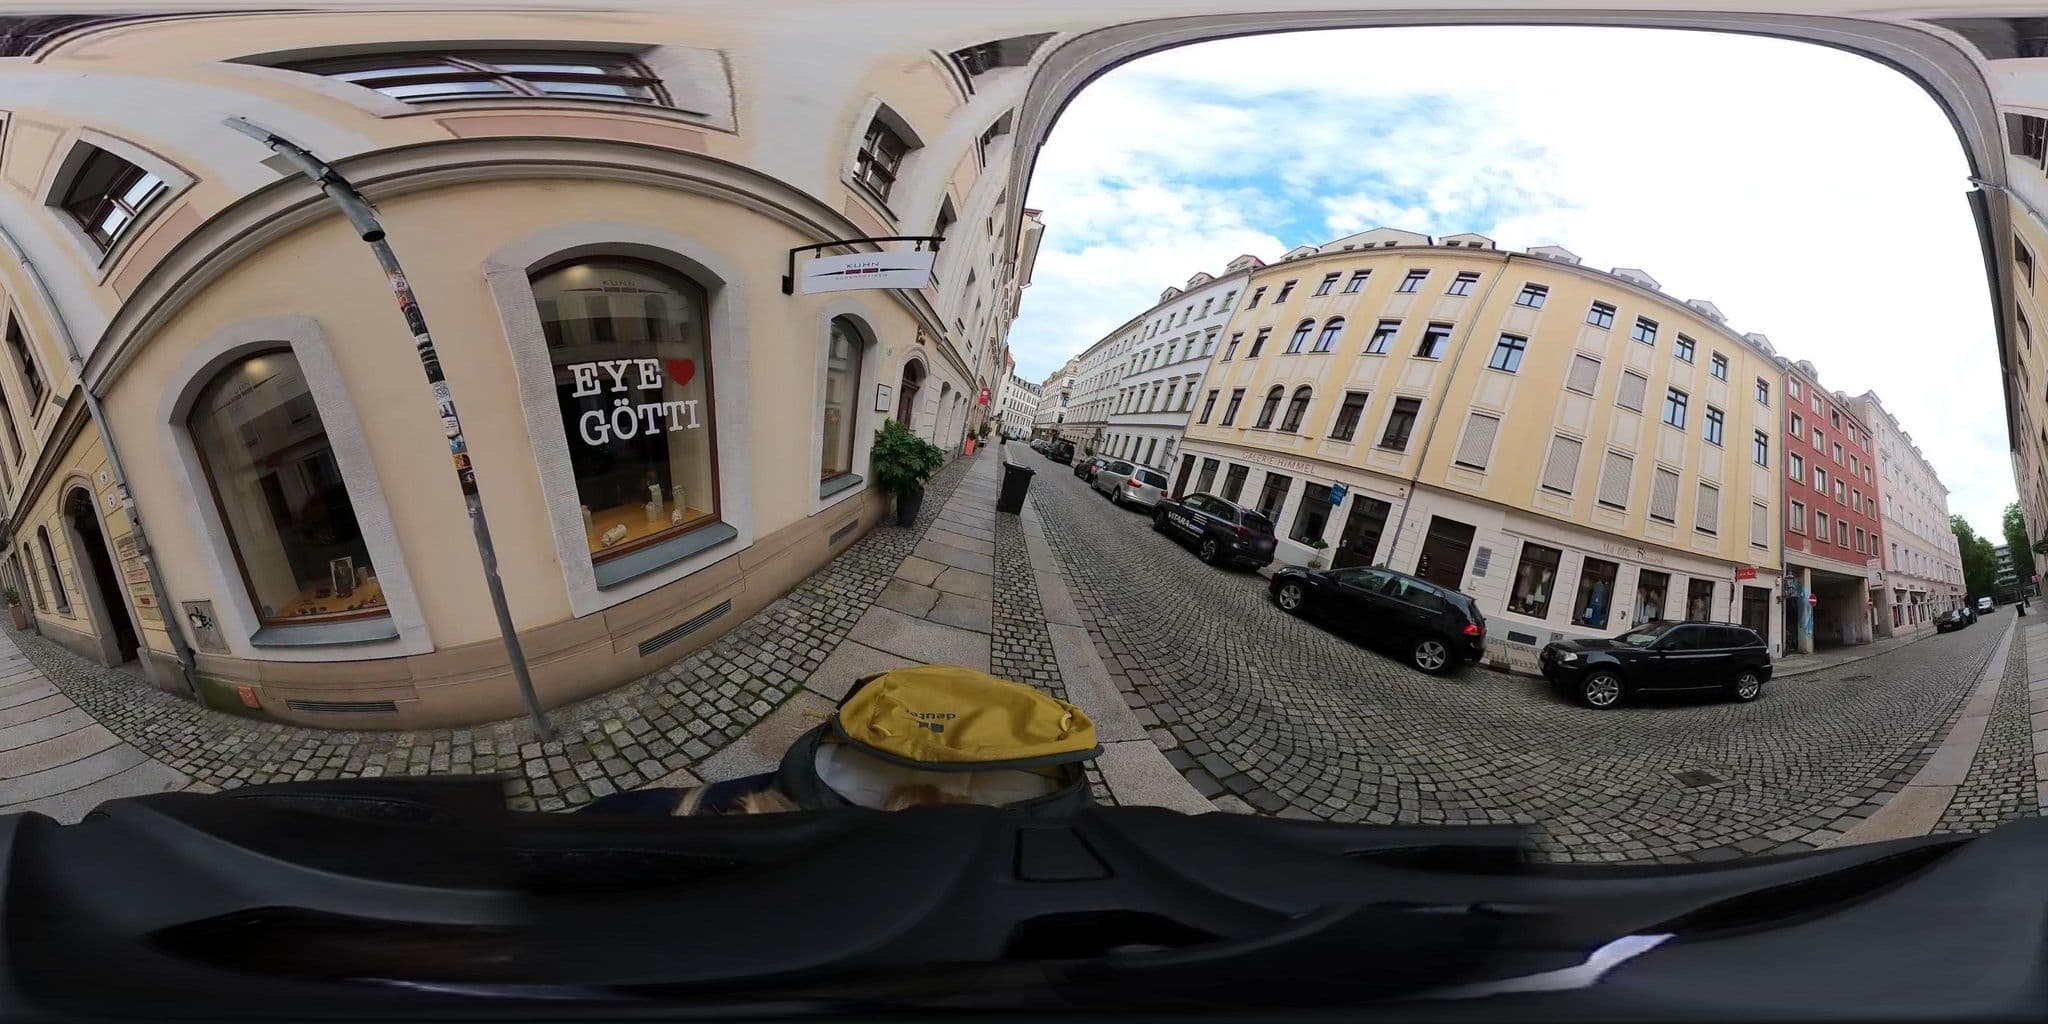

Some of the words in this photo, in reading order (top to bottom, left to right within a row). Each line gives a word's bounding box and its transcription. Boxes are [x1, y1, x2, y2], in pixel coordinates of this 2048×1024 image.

[567, 358, 663, 399] EYE
[580, 397, 701, 446] GÖTTI
[1242, 451, 1274, 465] GALERIE
[1277, 458, 1317, 475] HIMMEL
[1167, 511, 1190, 527] VITARA
